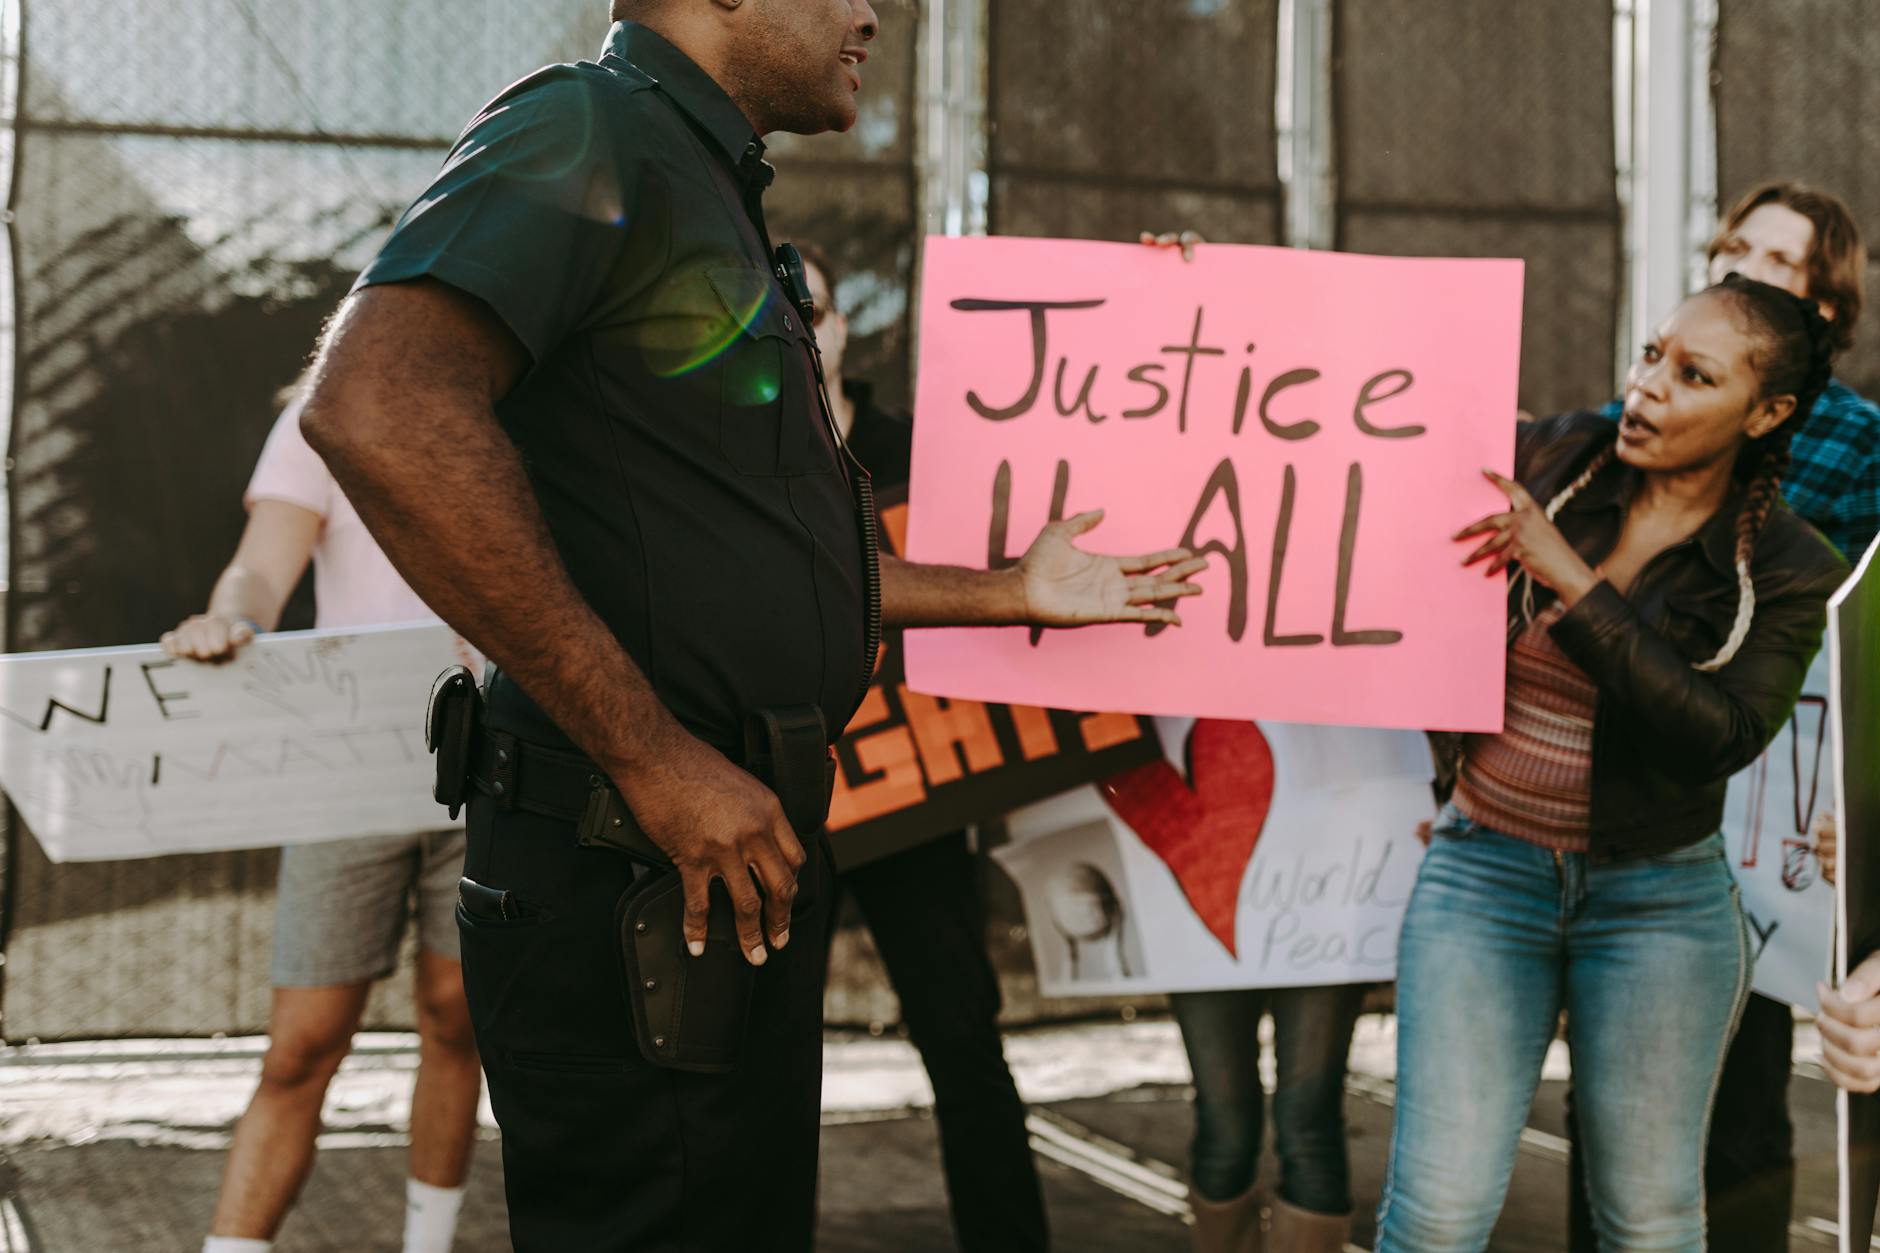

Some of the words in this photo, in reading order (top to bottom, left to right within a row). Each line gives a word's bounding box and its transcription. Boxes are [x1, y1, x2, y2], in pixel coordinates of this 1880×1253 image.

[950, 298, 1427, 440] Justice
[1145, 457, 1403, 647] ALL
[1249, 834, 1405, 911] World
[1258, 908, 1398, 974] Peac
